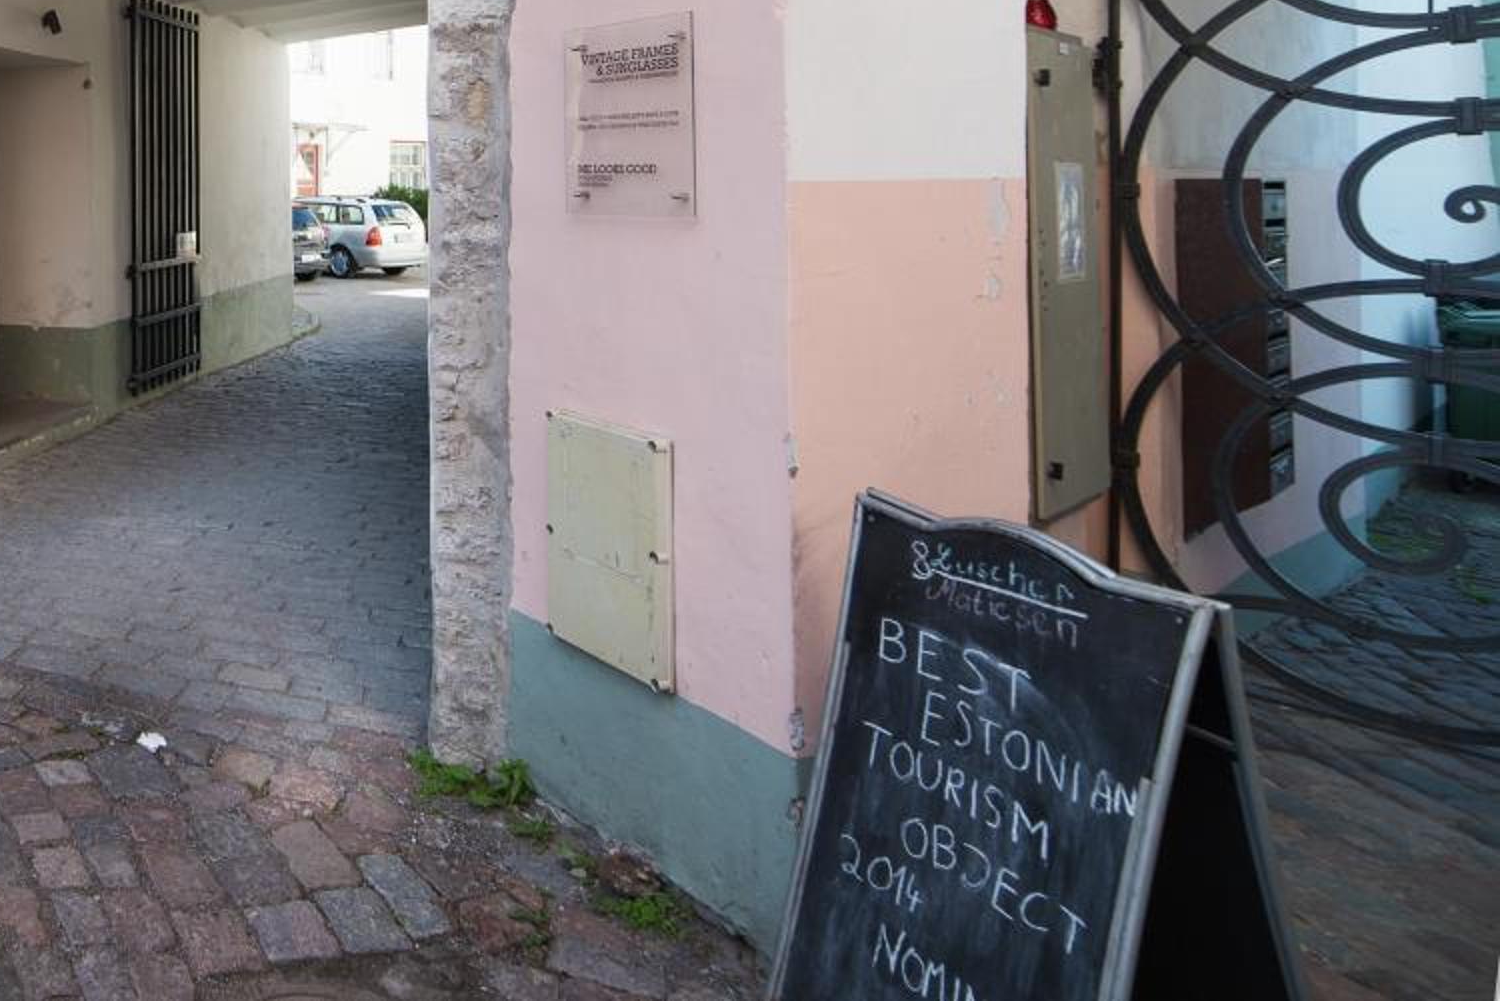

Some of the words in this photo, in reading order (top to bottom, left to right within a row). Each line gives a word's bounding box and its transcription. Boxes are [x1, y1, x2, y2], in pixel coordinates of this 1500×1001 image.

[581, 49, 630, 66] VINTAGE
[631, 42, 679, 60] FRAMES
[605, 56, 679, 75] SUNGLASSES
[878, 618, 1031, 712] BEST
[863, 720, 1049, 863] TOURISM
[921, 690, 1141, 817] ESTONIAN
[840, 833, 923, 913] 2014
[902, 817, 1088, 955] OBJECT
